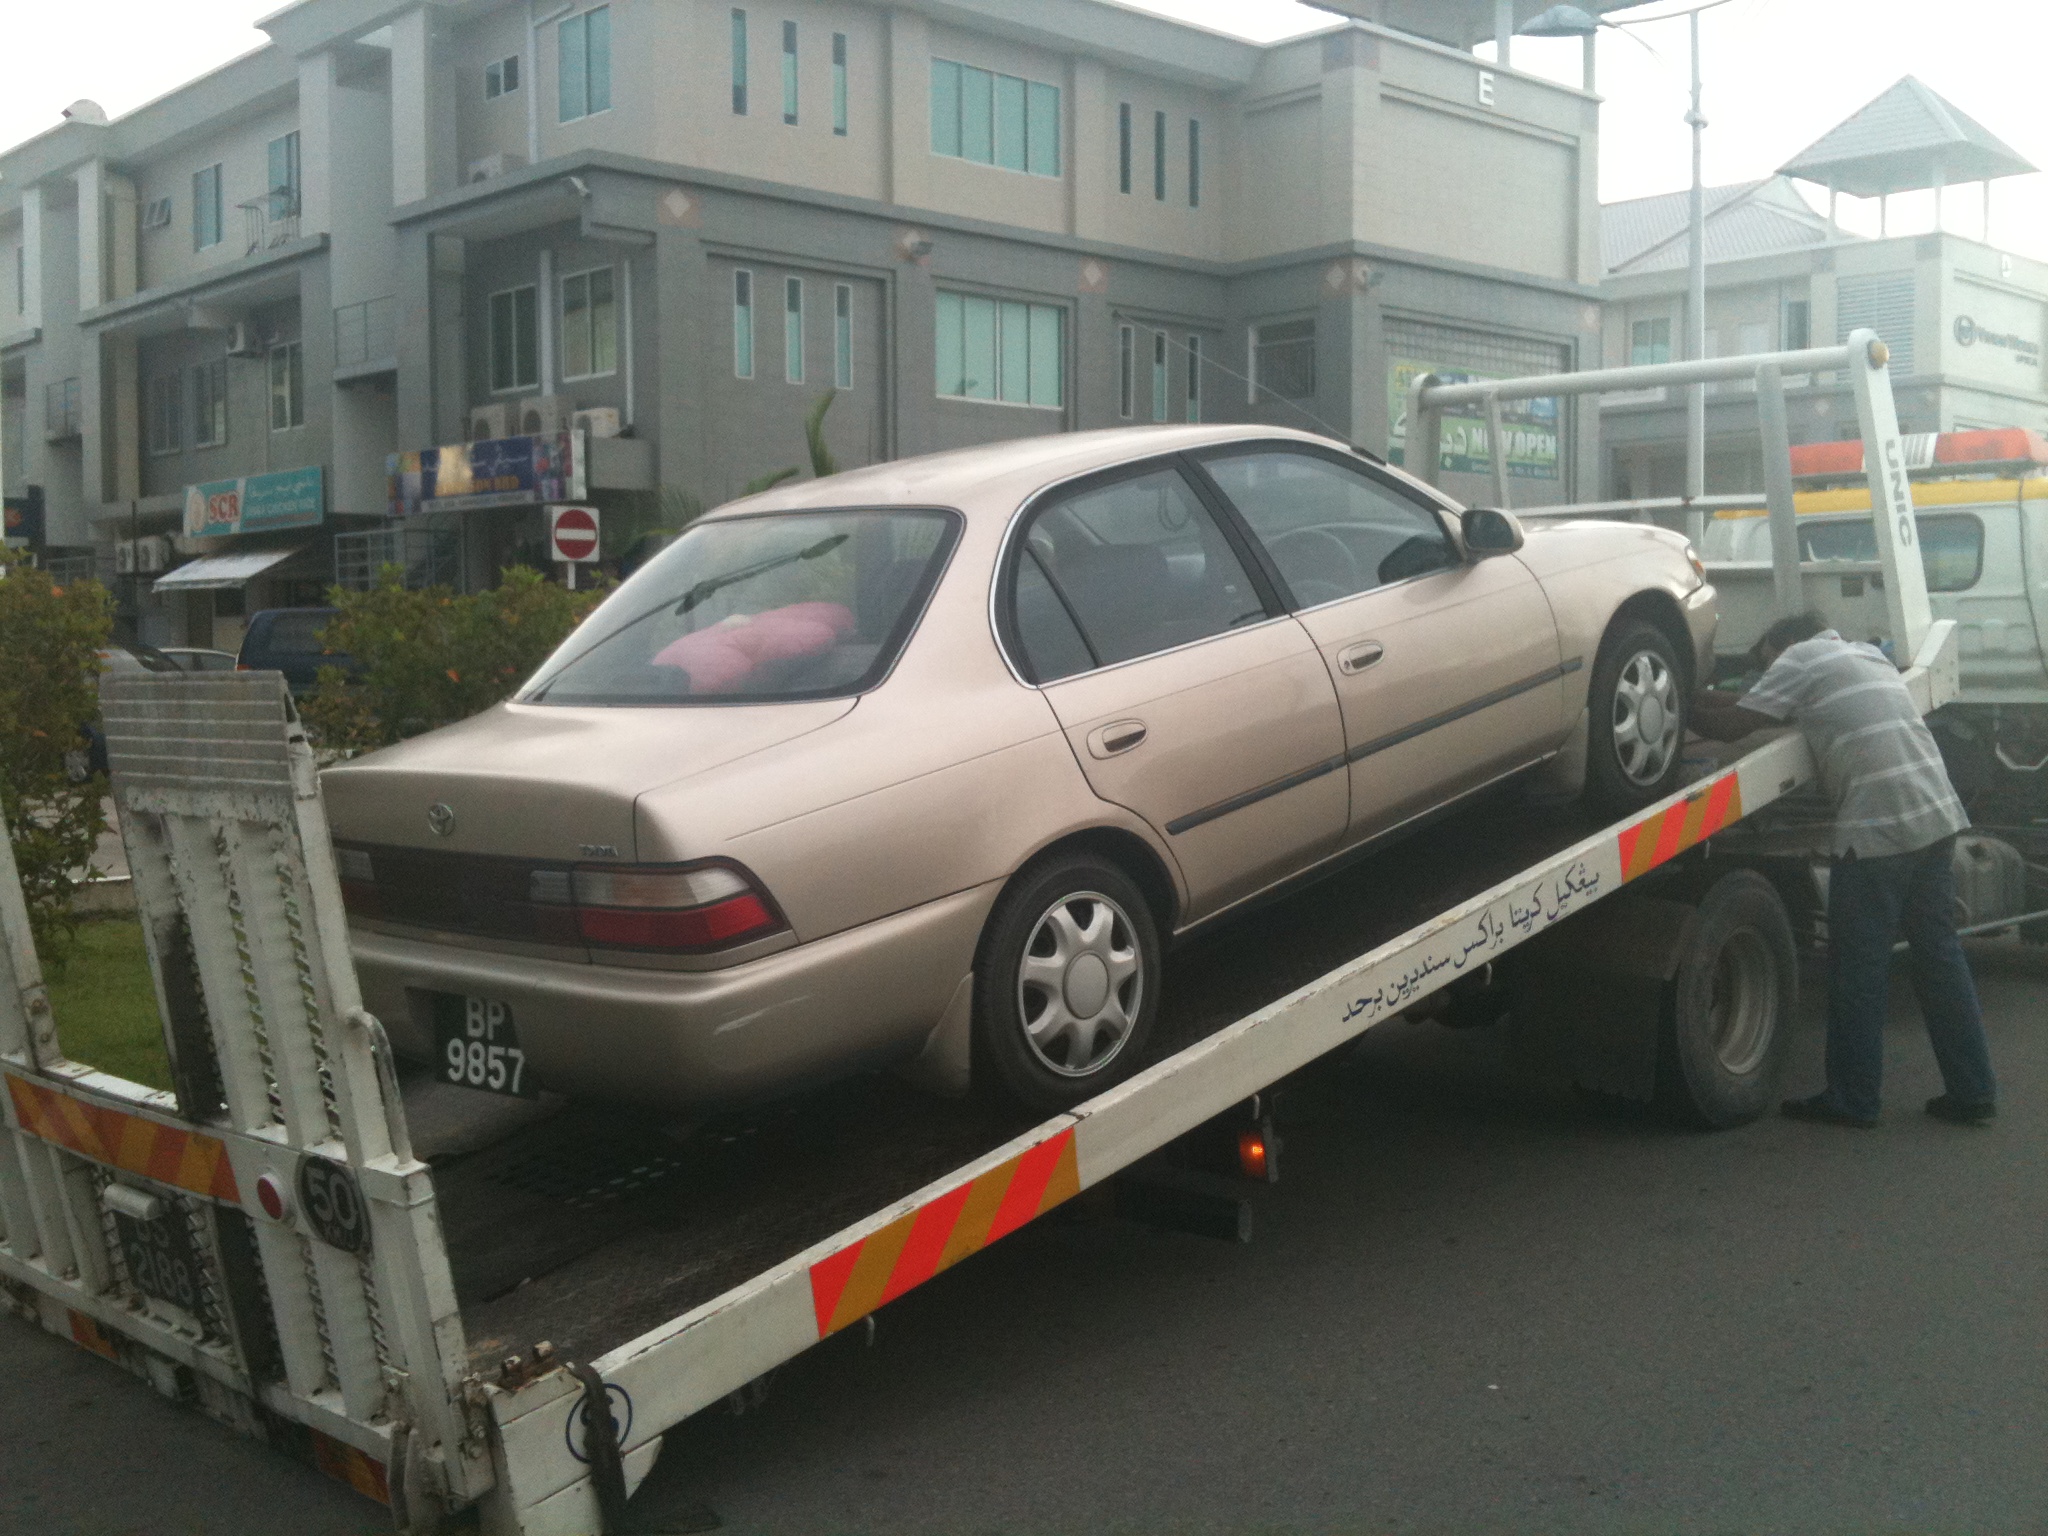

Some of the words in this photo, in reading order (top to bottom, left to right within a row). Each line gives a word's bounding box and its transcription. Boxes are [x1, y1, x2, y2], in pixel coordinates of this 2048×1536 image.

[1479, 71, 1494, 106] E
[1514, 430, 1557, 457] OPEN
[1885, 439, 1912, 547] UNIC
[465, 998, 505, 1040] BP
[447, 1038, 526, 1094] 9857
[305, 1164, 358, 1231] 50
[129, 1242, 194, 1306] 2188
